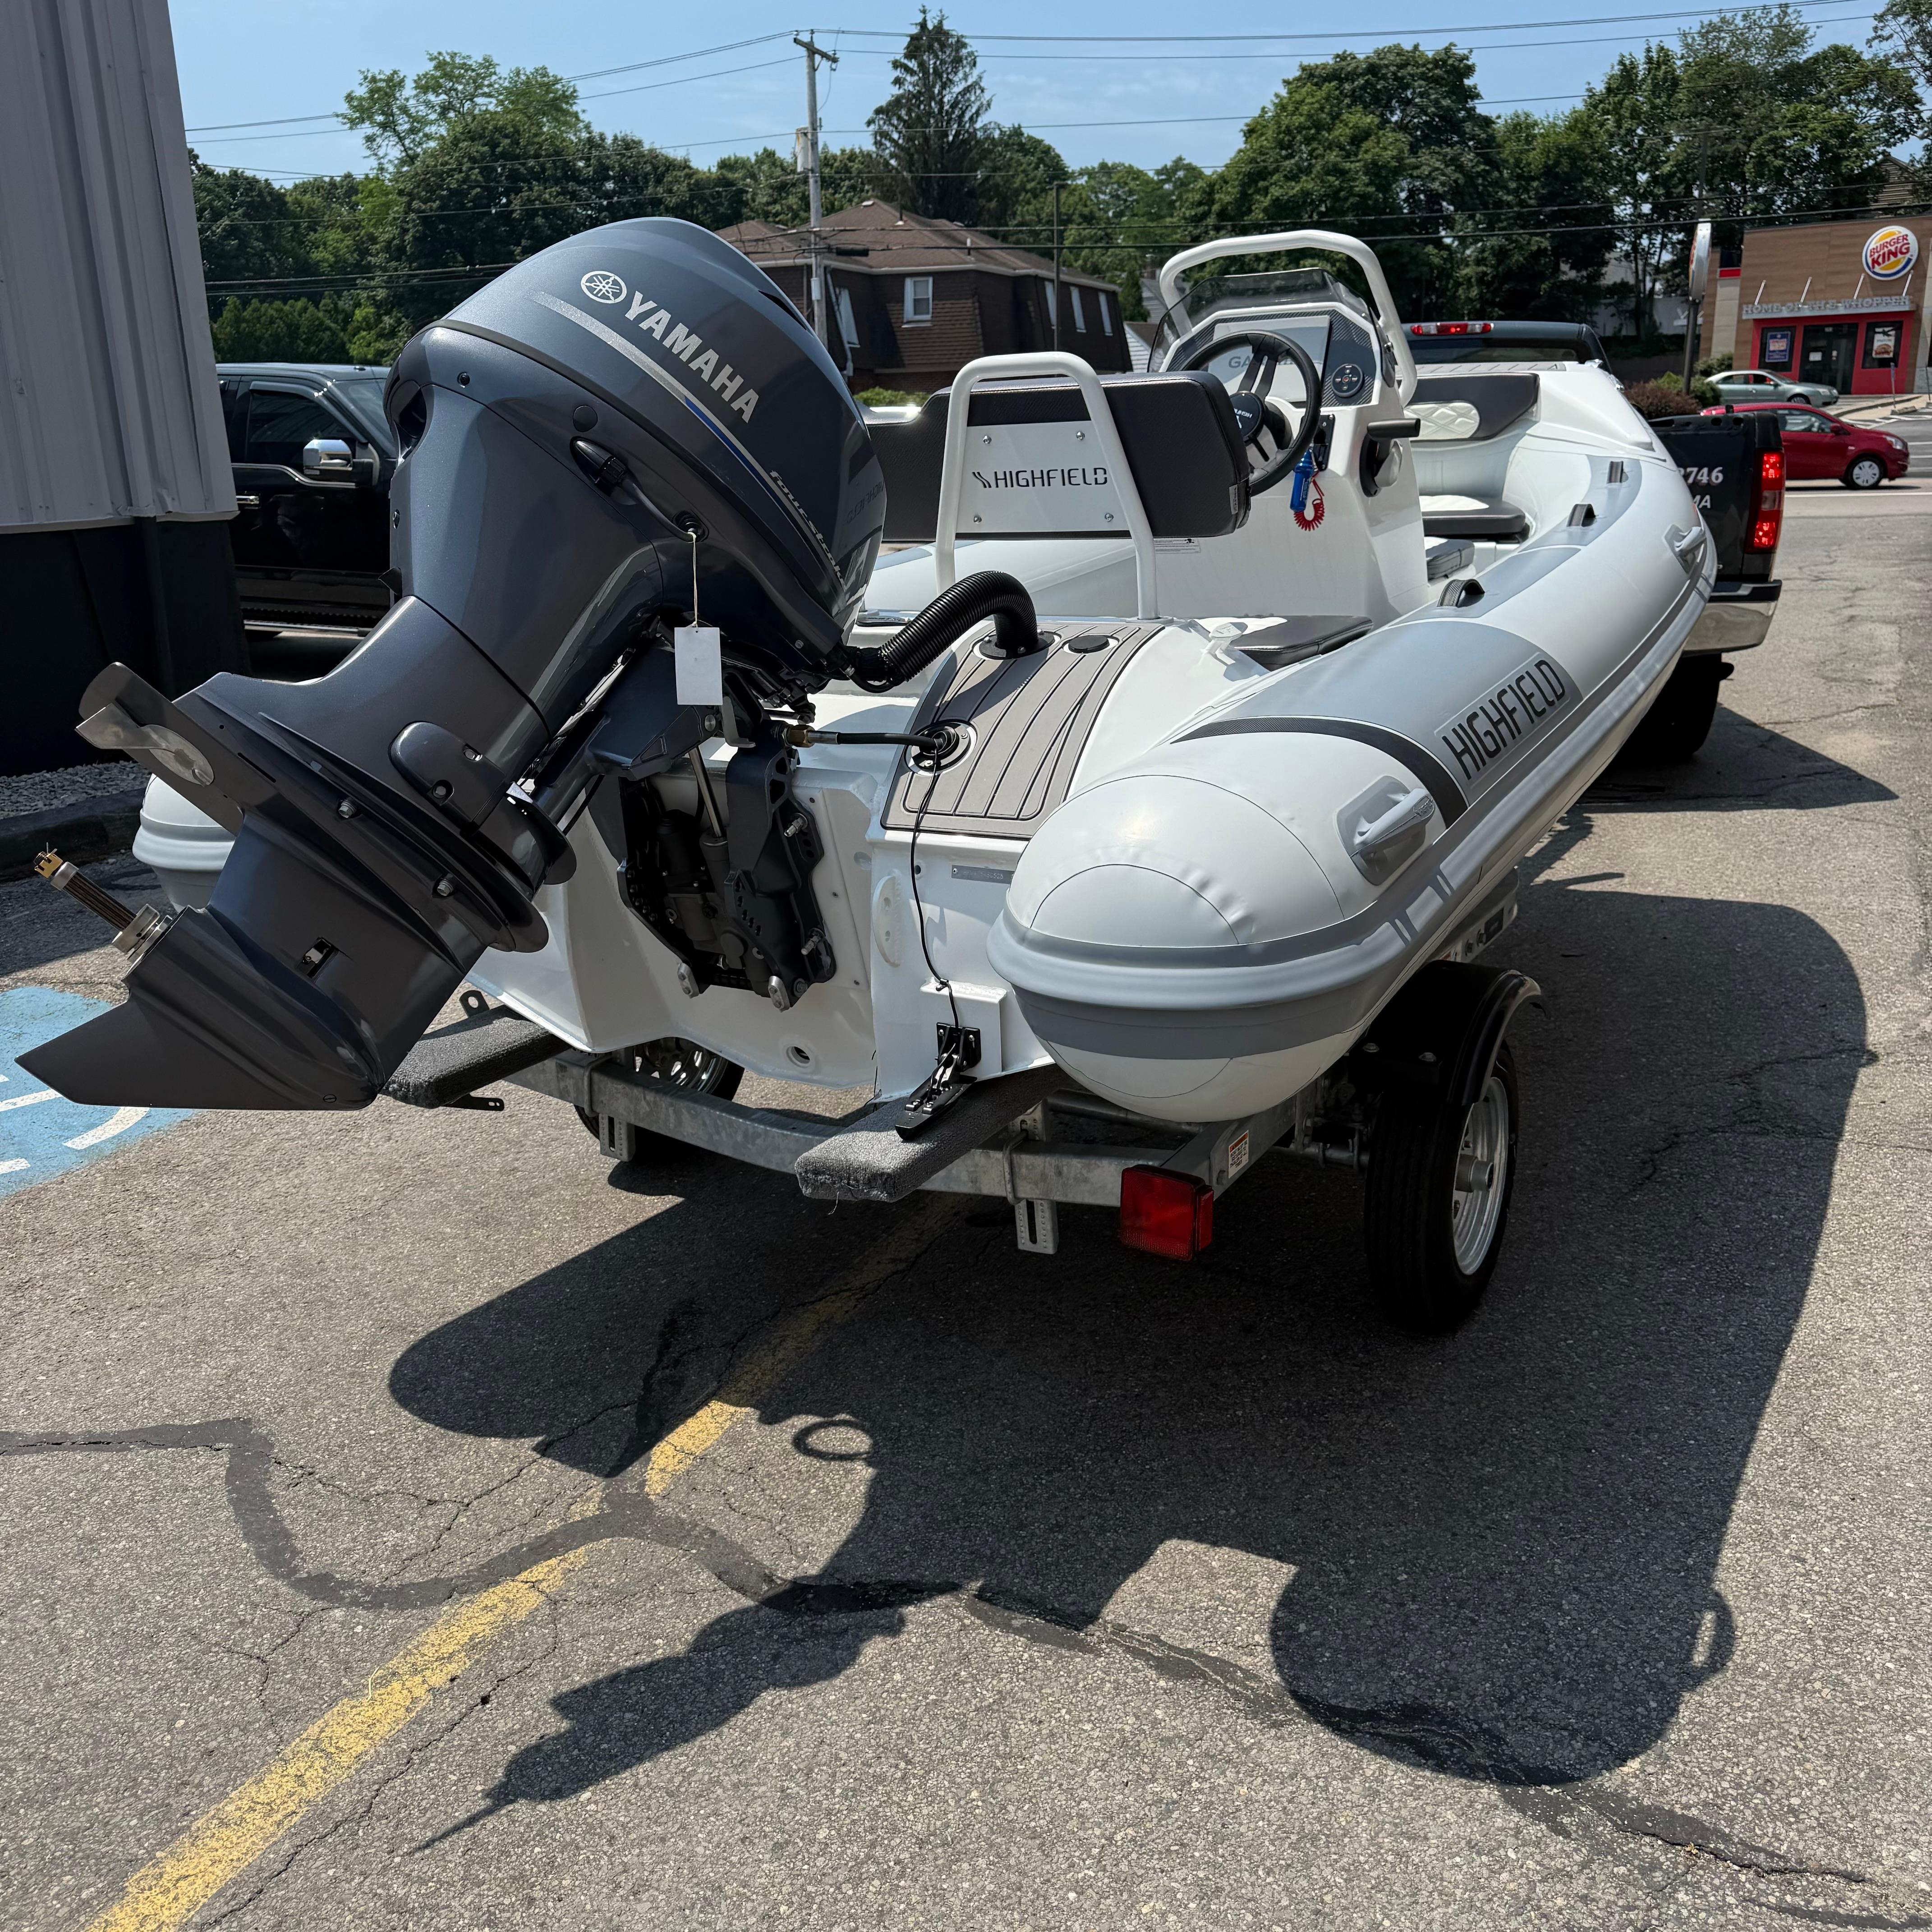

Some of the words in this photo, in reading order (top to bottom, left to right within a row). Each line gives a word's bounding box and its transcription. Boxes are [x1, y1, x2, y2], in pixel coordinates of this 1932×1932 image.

[1869, 234, 1909, 258] BURGER
[1871, 242, 1910, 270] KING
[1742, 304, 1782, 314] HOME
[1785, 302, 1802, 313] OF
[1841, 295, 1910, 310] WHOPPER
[625, 290, 759, 423] YAMAHA
[994, 467, 1108, 488] HIGHFIELD
[1441, 659, 1565, 780] HIGHFIELD
